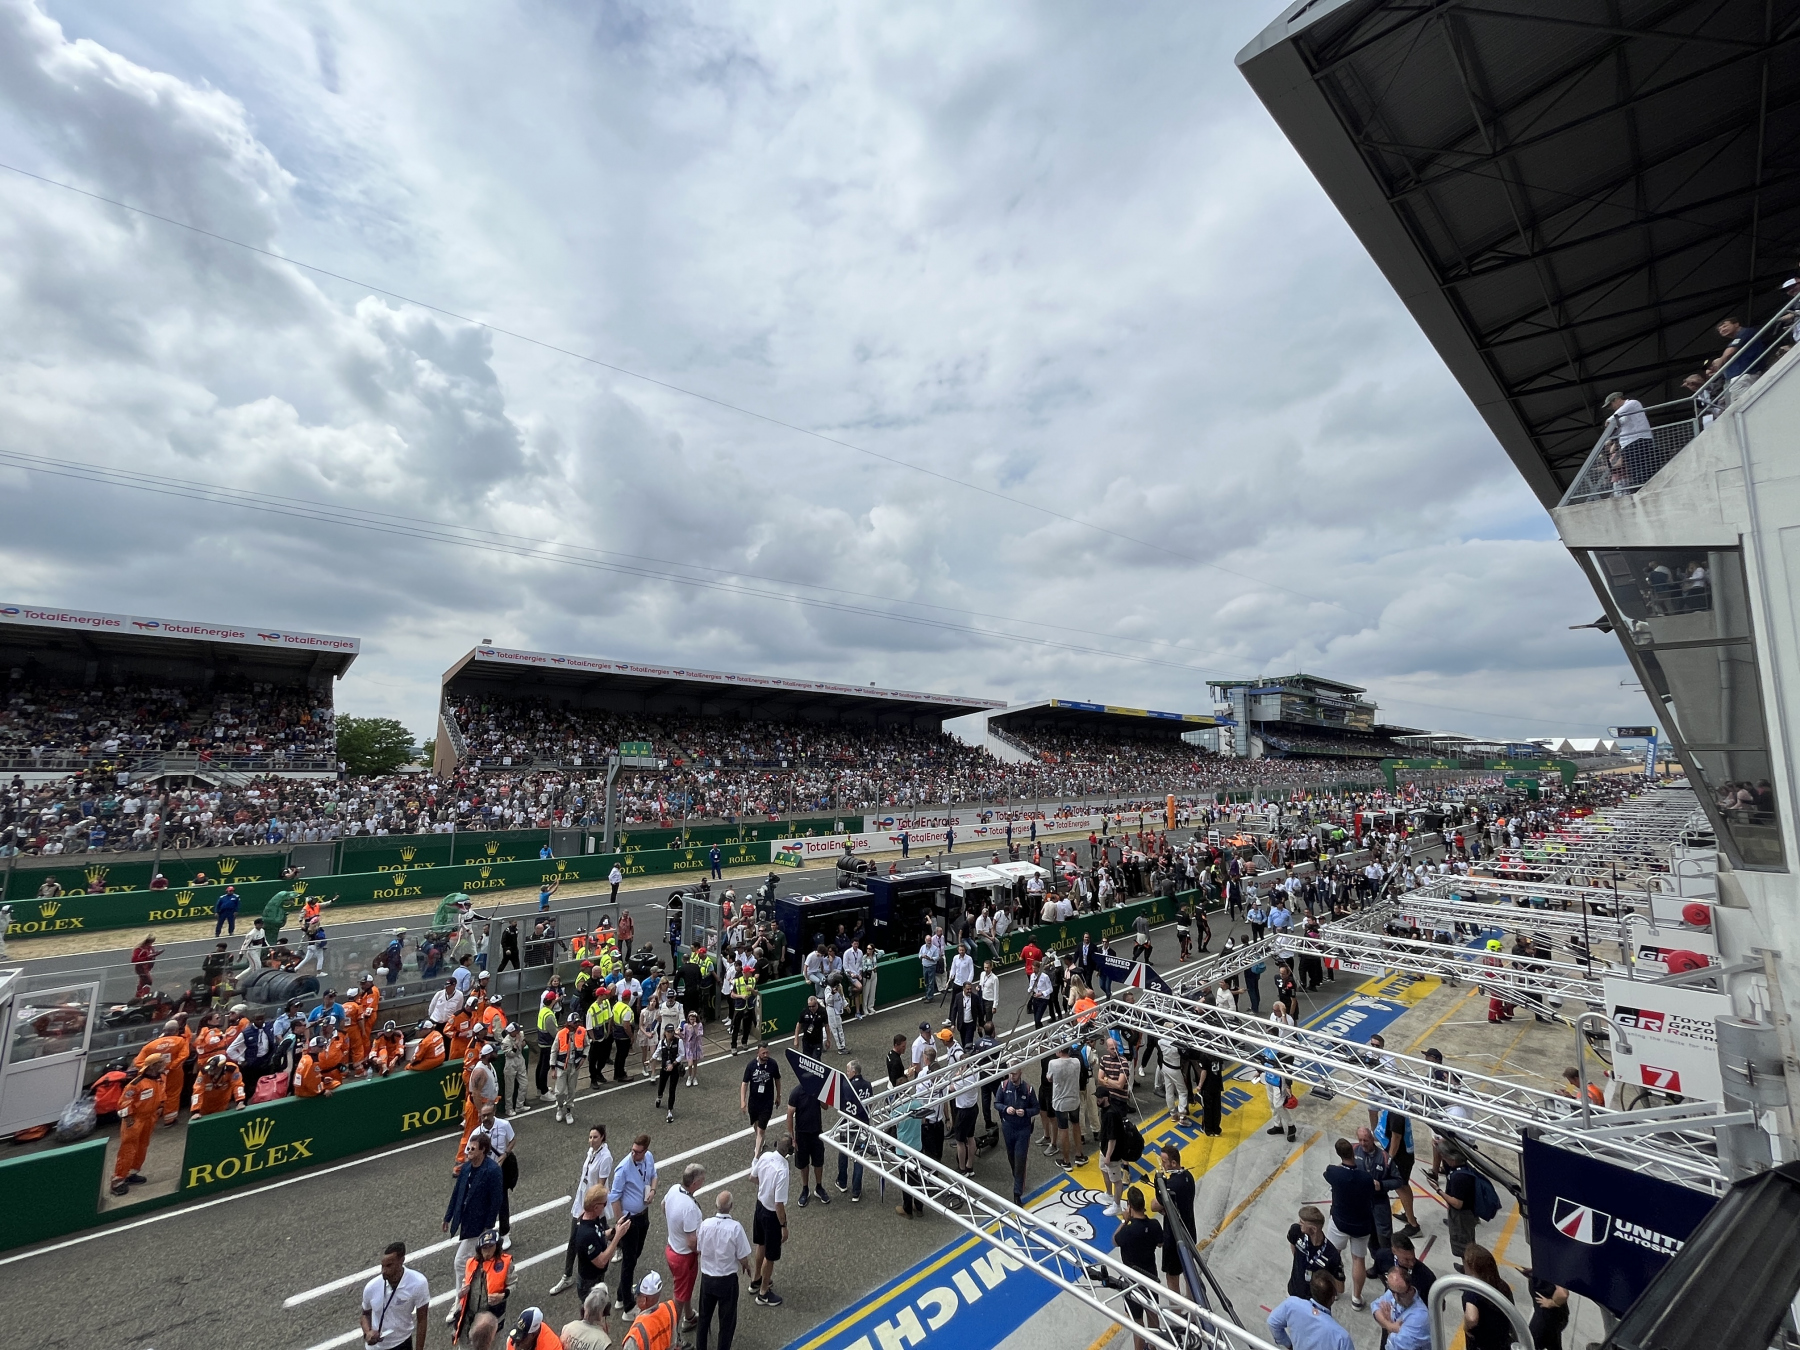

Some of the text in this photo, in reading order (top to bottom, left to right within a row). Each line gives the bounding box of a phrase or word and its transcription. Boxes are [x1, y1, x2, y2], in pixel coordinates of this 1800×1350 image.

[23, 610, 121, 627] TotalEnergies
[162, 623, 245, 639] TotalEnergies
[282, 634, 354, 649] TotalEnergies
[496, 651, 547, 663] TotalEnergies
[567, 658, 611, 670] TotalEnergies
[629, 665, 670, 675] TotalEnergies
[1056, 820, 1090, 831] TotalEnergies
[673, 859, 704, 870] ROLEX
[728, 854, 756, 864] ROLEX
[541, 871, 580, 883] ROLEX
[619, 865, 645, 875] OLEX
[463, 878, 506, 890] ROLEX
[373, 886, 422, 899] ROLEX
[149, 905, 215, 922] ROLEX
[7, 917, 84, 935] ROLEX
[1101, 924, 1125, 938] ROLEX
[1051, 937, 1077, 951] ROLEX
[1105, 956, 1130, 967] UNITED
[1150, 981, 1162, 991] 22
[1613, 1012, 1664, 1033] GR
[1670, 1013, 1715, 1028] TOYO
[1669, 1021, 1716, 1035] GAZO
[798, 1056, 825, 1074] UNITED
[1646, 1066, 1674, 1088] 7
[401, 1099, 466, 1132] ROL
[845, 1101, 858, 1116] 23
[186, 1138, 314, 1189] ROLEX
[1614, 1218, 1686, 1251] UNIT
[1613, 1230, 1678, 1258] AUTOSP
